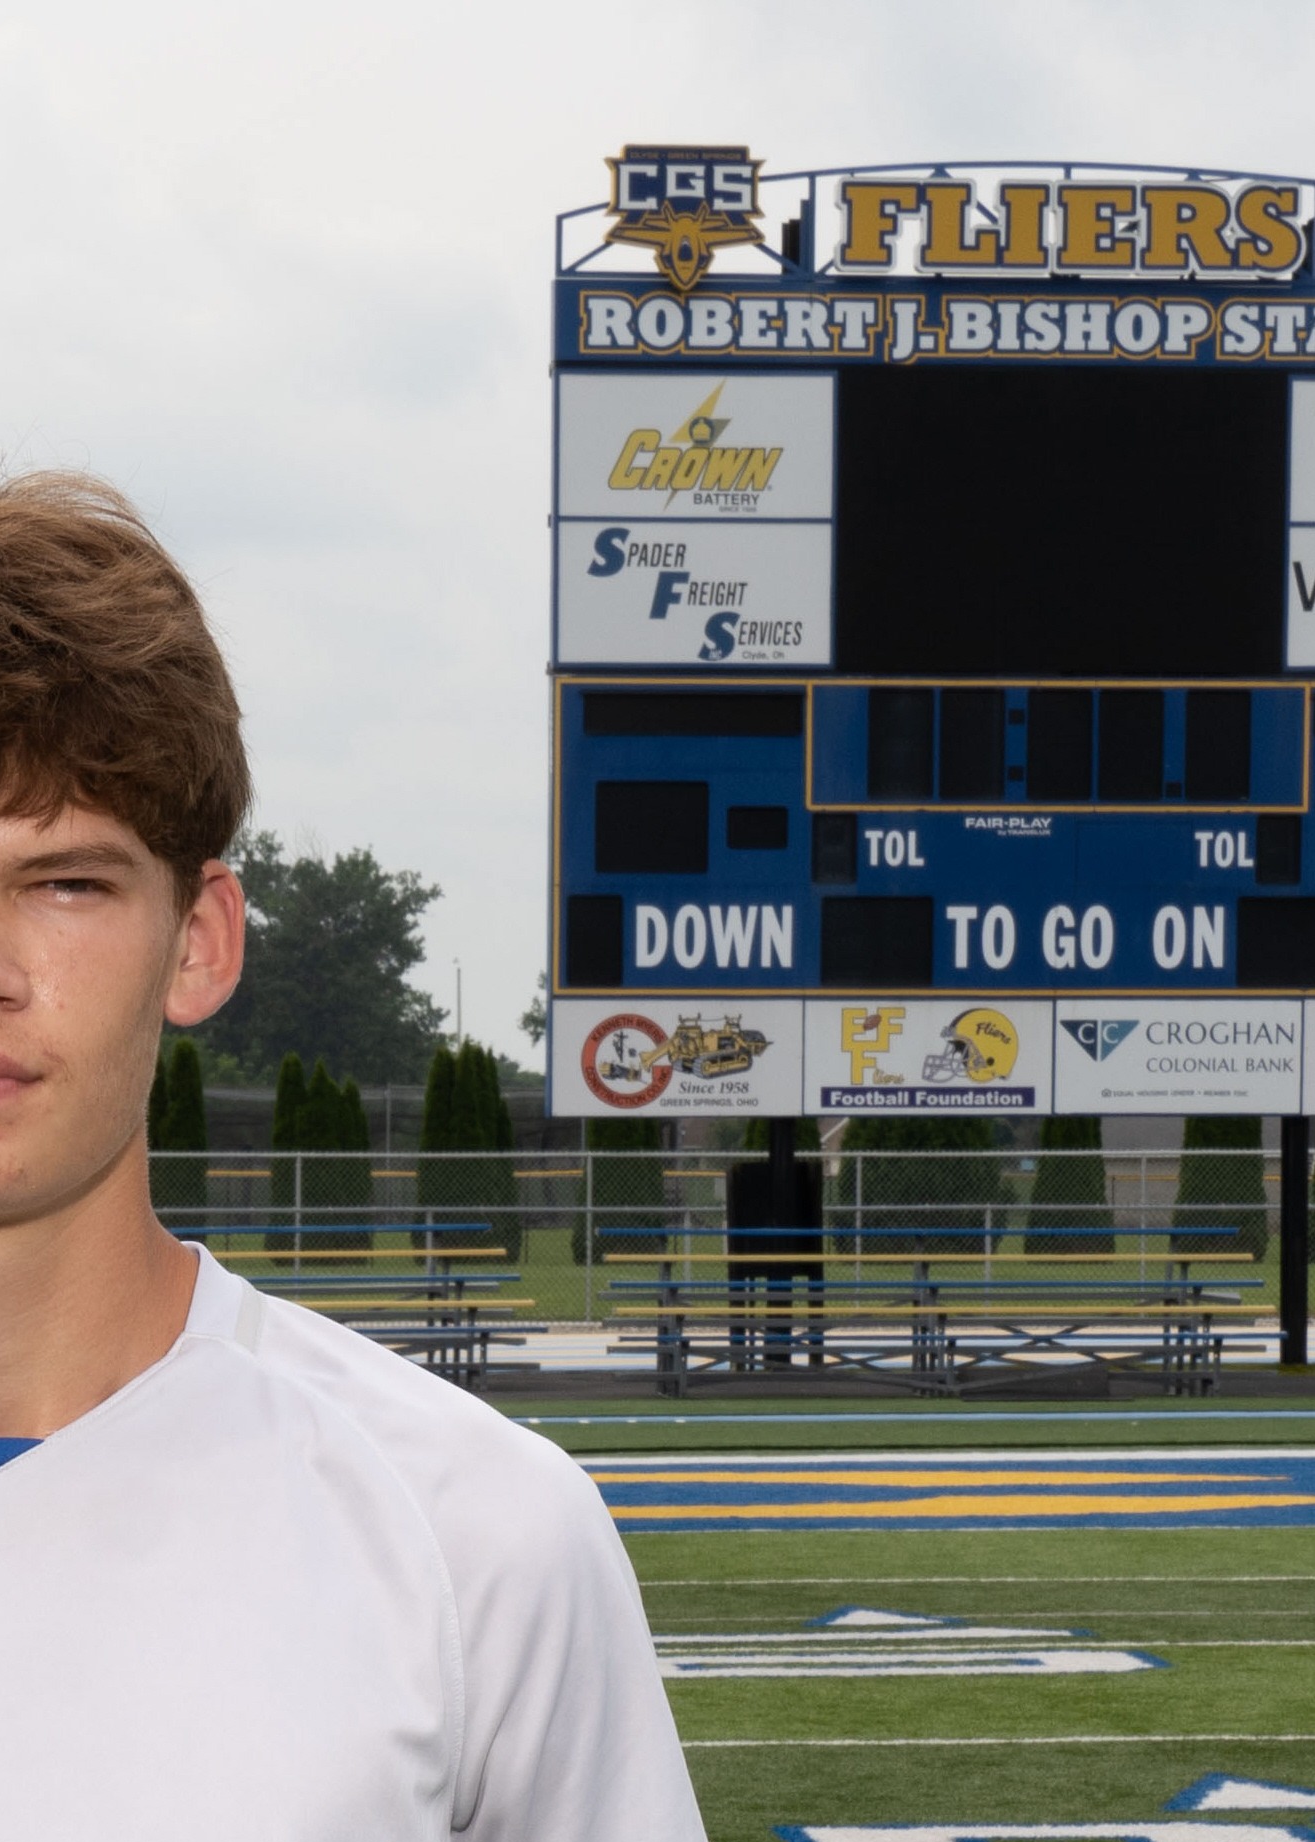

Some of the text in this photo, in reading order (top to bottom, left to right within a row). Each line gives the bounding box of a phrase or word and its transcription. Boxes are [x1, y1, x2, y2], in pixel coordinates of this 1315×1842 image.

[618, 164, 753, 211] CGS
[837, 180, 1306, 273] FLIERS
[586, 297, 876, 350] ROBERT
[892, 301, 936, 360] J.
[949, 302, 1209, 352] BISHOP
[607, 428, 783, 491] CROWN
[693, 493, 760, 505] BATTERY
[587, 527, 687, 577] SPADER
[649, 571, 748, 619] FREIGHT
[698, 611, 803, 661] SERVICES
[865, 830, 925, 867] TOL
[1195, 832, 1254, 868] TOL
[635, 905, 793, 969] DOWN
[946, 905, 1225, 969] TO GO ON
[976, 1022, 1011, 1045] Fliers
[1145, 1021, 1295, 1045] CROGHAN
[1146, 1057, 1295, 1073] COLONIAL BANK
[660, 1098, 691, 1107] GREEN
[736, 1098, 759, 1107] OHIO
[679, 1081, 749, 1094] Since 1958
[830, 1091, 1023, 1106] Football Foundation
